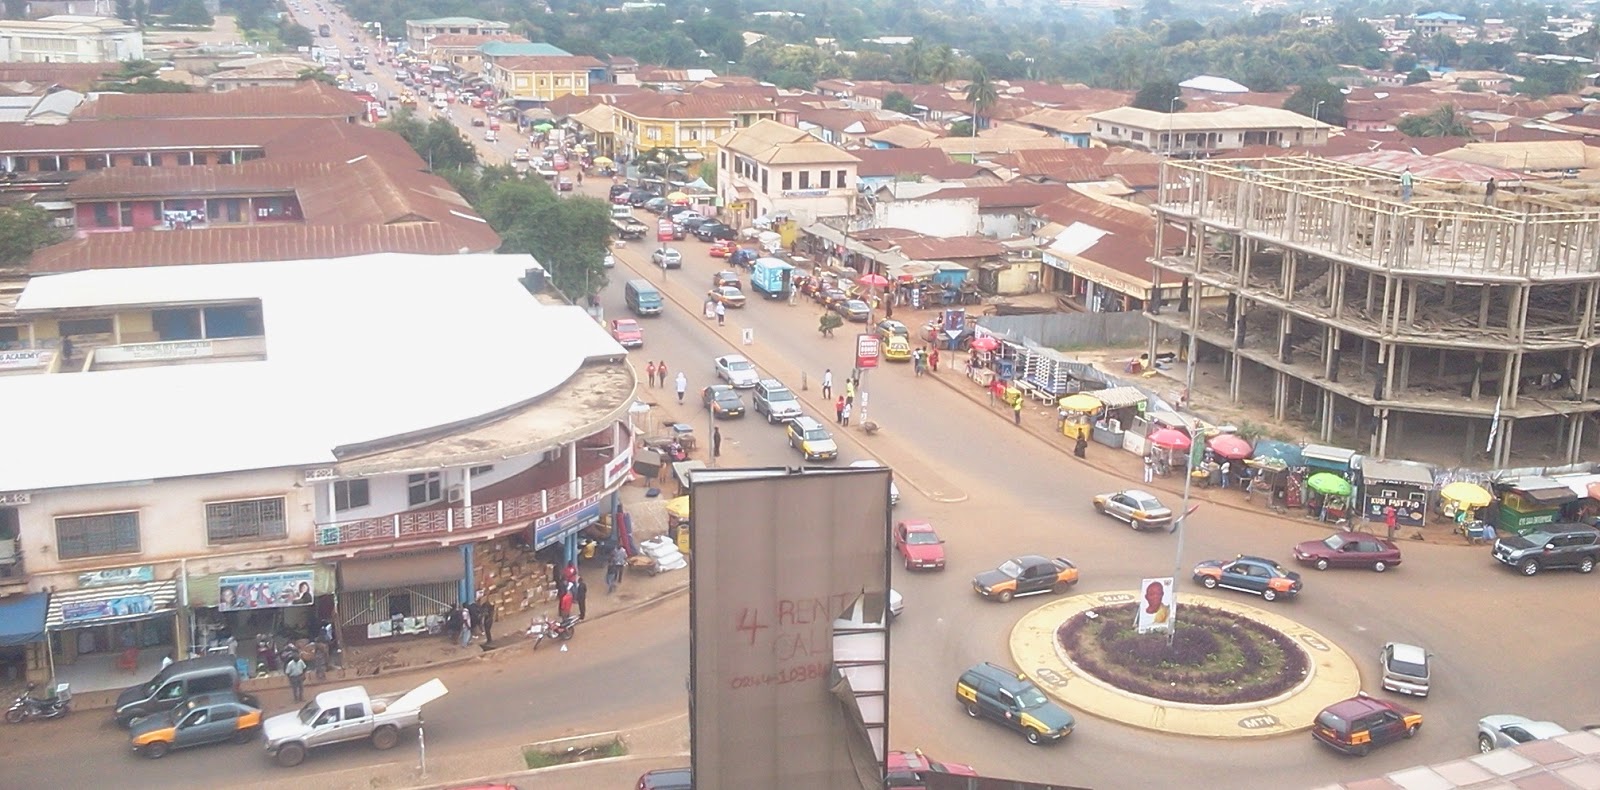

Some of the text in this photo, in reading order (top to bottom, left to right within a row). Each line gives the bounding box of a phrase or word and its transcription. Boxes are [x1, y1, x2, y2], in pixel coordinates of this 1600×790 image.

[6, 352, 39, 360] ACADEMY
[1371, 497, 1386, 506] KUSI
[1389, 498, 1404, 507] FAST
[737, 594, 849, 643] 4 RENT
[1243, 716, 1276, 728] MTN
